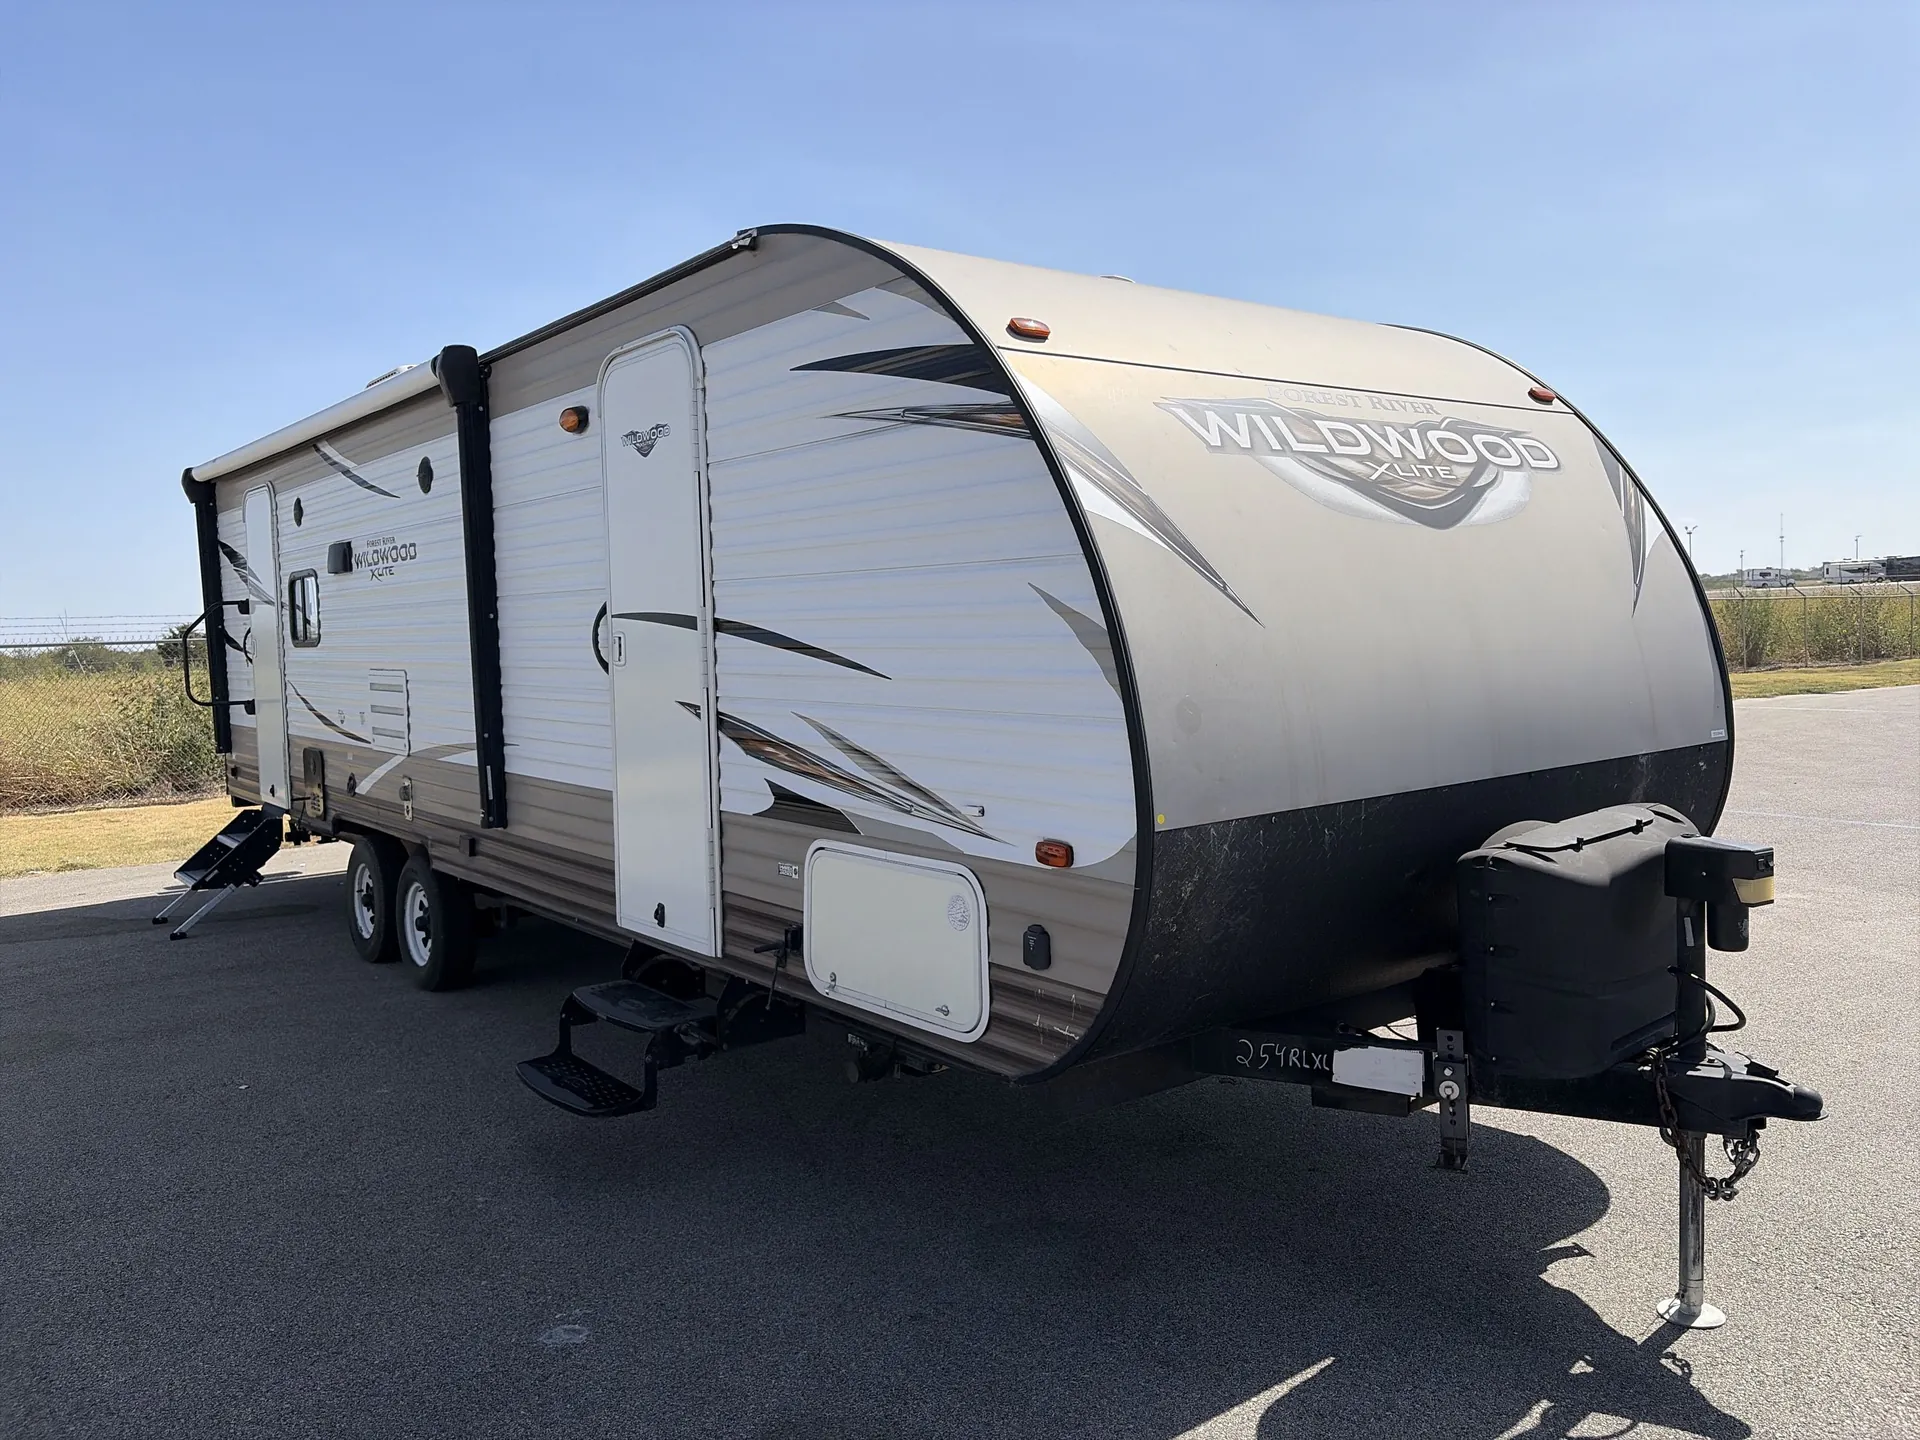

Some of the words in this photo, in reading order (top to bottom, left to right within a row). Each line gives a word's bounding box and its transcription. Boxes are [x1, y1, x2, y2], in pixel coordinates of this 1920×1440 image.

[1265, 384, 1362, 409] FOREST
[1365, 395, 1441, 415] RIVER
[621, 426, 670, 447] WILDWOOD
[1173, 402, 1560, 470] WILDWOOD
[1364, 461, 1458, 482] XLITE
[367, 539, 381, 548] FOREST
[382, 536, 395, 546] RIVER
[354, 543, 417, 569] WILDWOOD
[370, 565, 395, 582] XLITE
